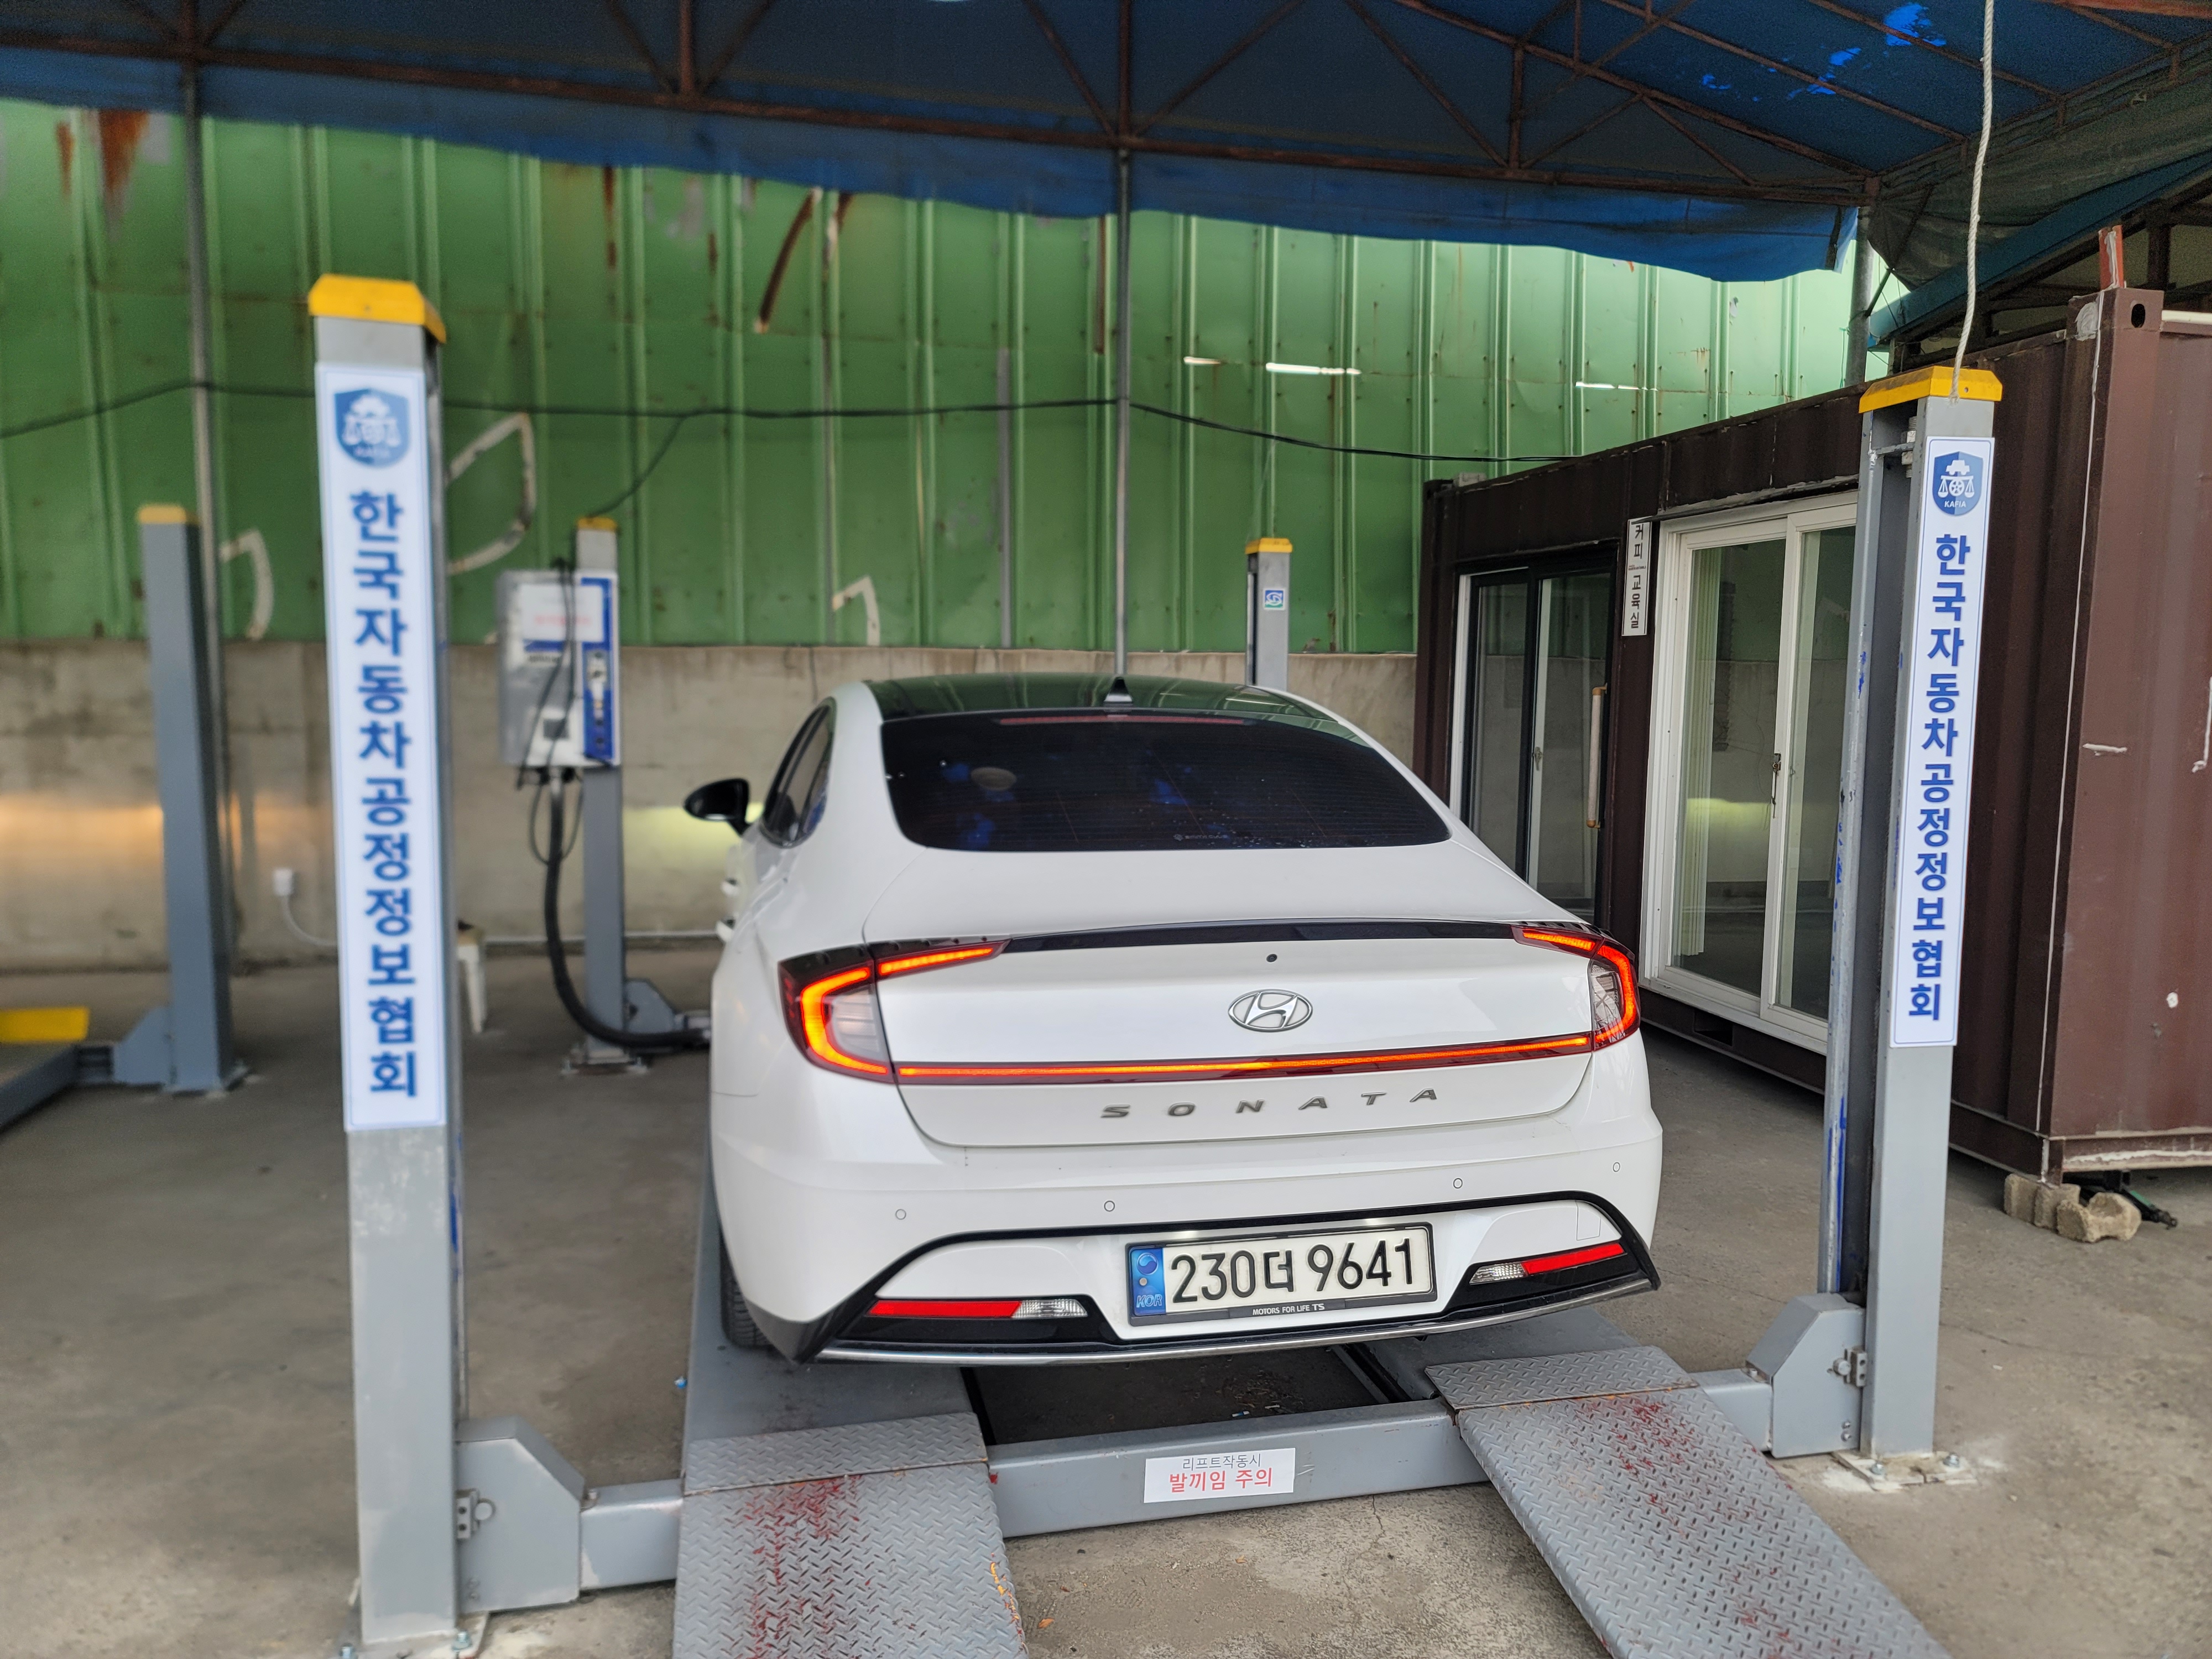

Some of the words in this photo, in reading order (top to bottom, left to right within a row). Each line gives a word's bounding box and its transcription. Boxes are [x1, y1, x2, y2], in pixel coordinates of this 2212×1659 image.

[1633, 523, 1644, 559] 커피
[1630, 575, 1641, 629] 교육실
[1908, 534, 1970, 1021] 한국자동차공정정보협회
[351, 491, 416, 1098] 한국자동차공정정보협회
[1100, 1087, 1438, 1118] SONATA
[1171, 1249, 1295, 1303] 230더
[1307, 1238, 1413, 1292] 9641
[1136, 1293, 1162, 1308] KOR
[1253, 1307, 1280, 1316] MOTORS
[1182, 1453, 1261, 1471] 리프트작동시
[1169, 1470, 1226, 1493] 발끼임
[1235, 1467, 1272, 1489] 주의
